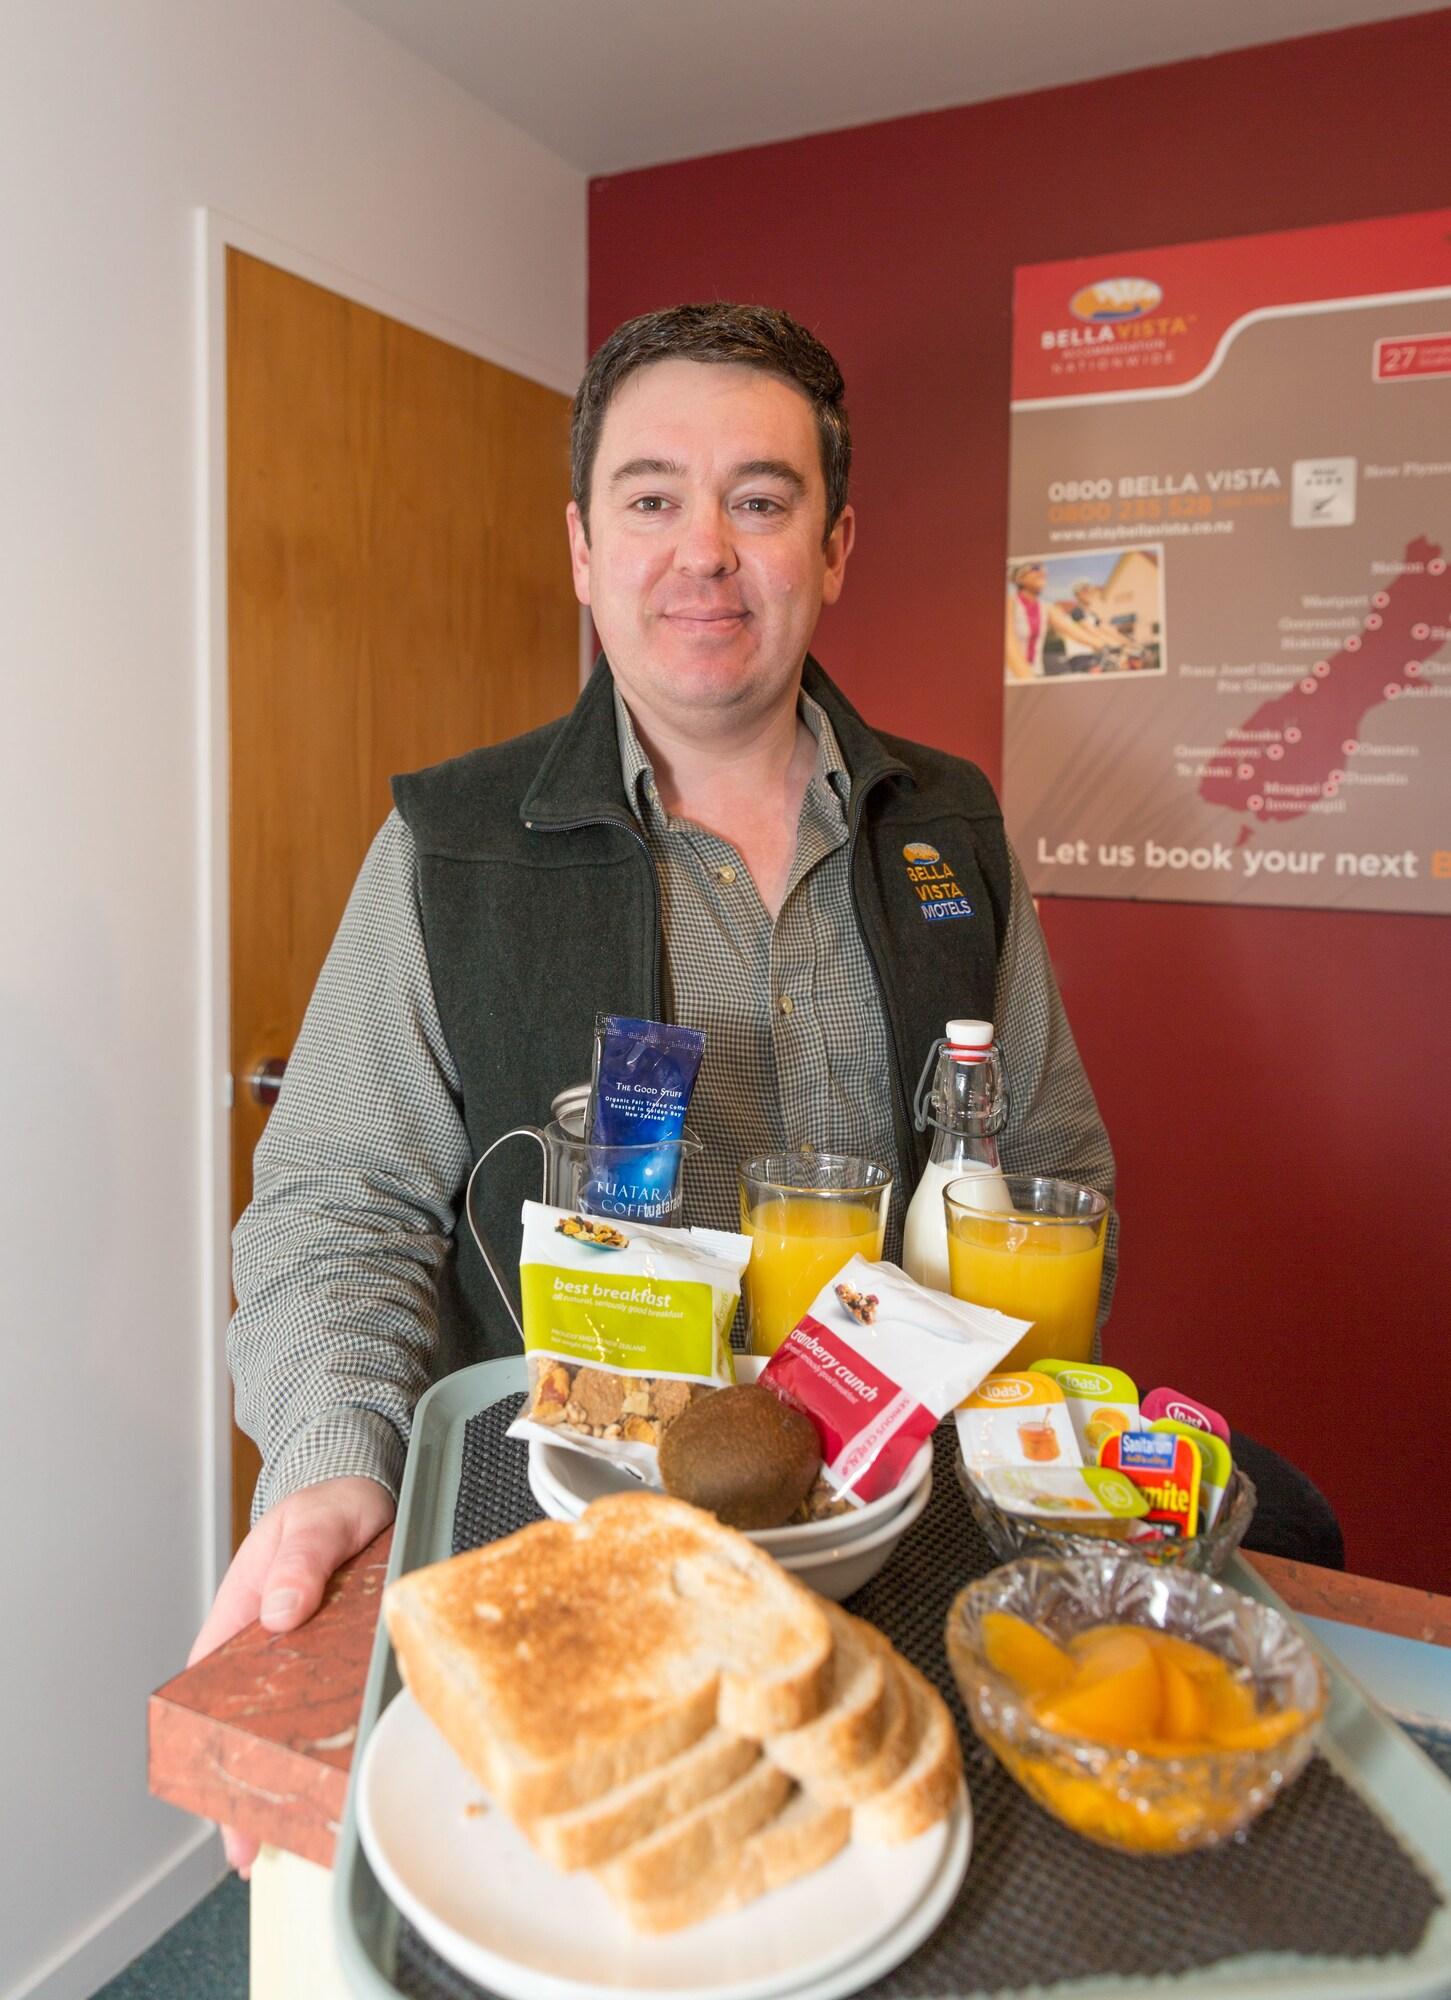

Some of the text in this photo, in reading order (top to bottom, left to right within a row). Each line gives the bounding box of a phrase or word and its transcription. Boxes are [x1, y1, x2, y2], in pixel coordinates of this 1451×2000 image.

[1051, 351, 1175, 374] NATIONWIDE
[1383, 346, 1417, 372] 27
[1048, 466, 1282, 501] 0800 BELLA VISTA
[1037, 837, 1090, 866] Let
[1098, 844, 1136, 867] us
[1145, 839, 1233, 871] book
[1242, 849, 1327, 877] your
[1335, 850, 1419, 878] next
[906, 863, 955, 882] BELLA
[914, 882, 965, 902] VISTA
[921, 900, 972, 919] MOTELS
[605, 1095, 630, 1104] Organic
[610, 1103, 635, 1111] Roasted
[646, 1108, 668, 1116] Golden
[670, 1110, 682, 1118] Bay
[640, 1113, 666, 1122] Zealand
[553, 1277, 672, 1308] best breakfast
[790, 1329, 840, 1369] cranberry
[835, 1365, 879, 1403] crunch
[985, 1384, 1021, 1399] toast
[1066, 1375, 1101, 1391] toast
